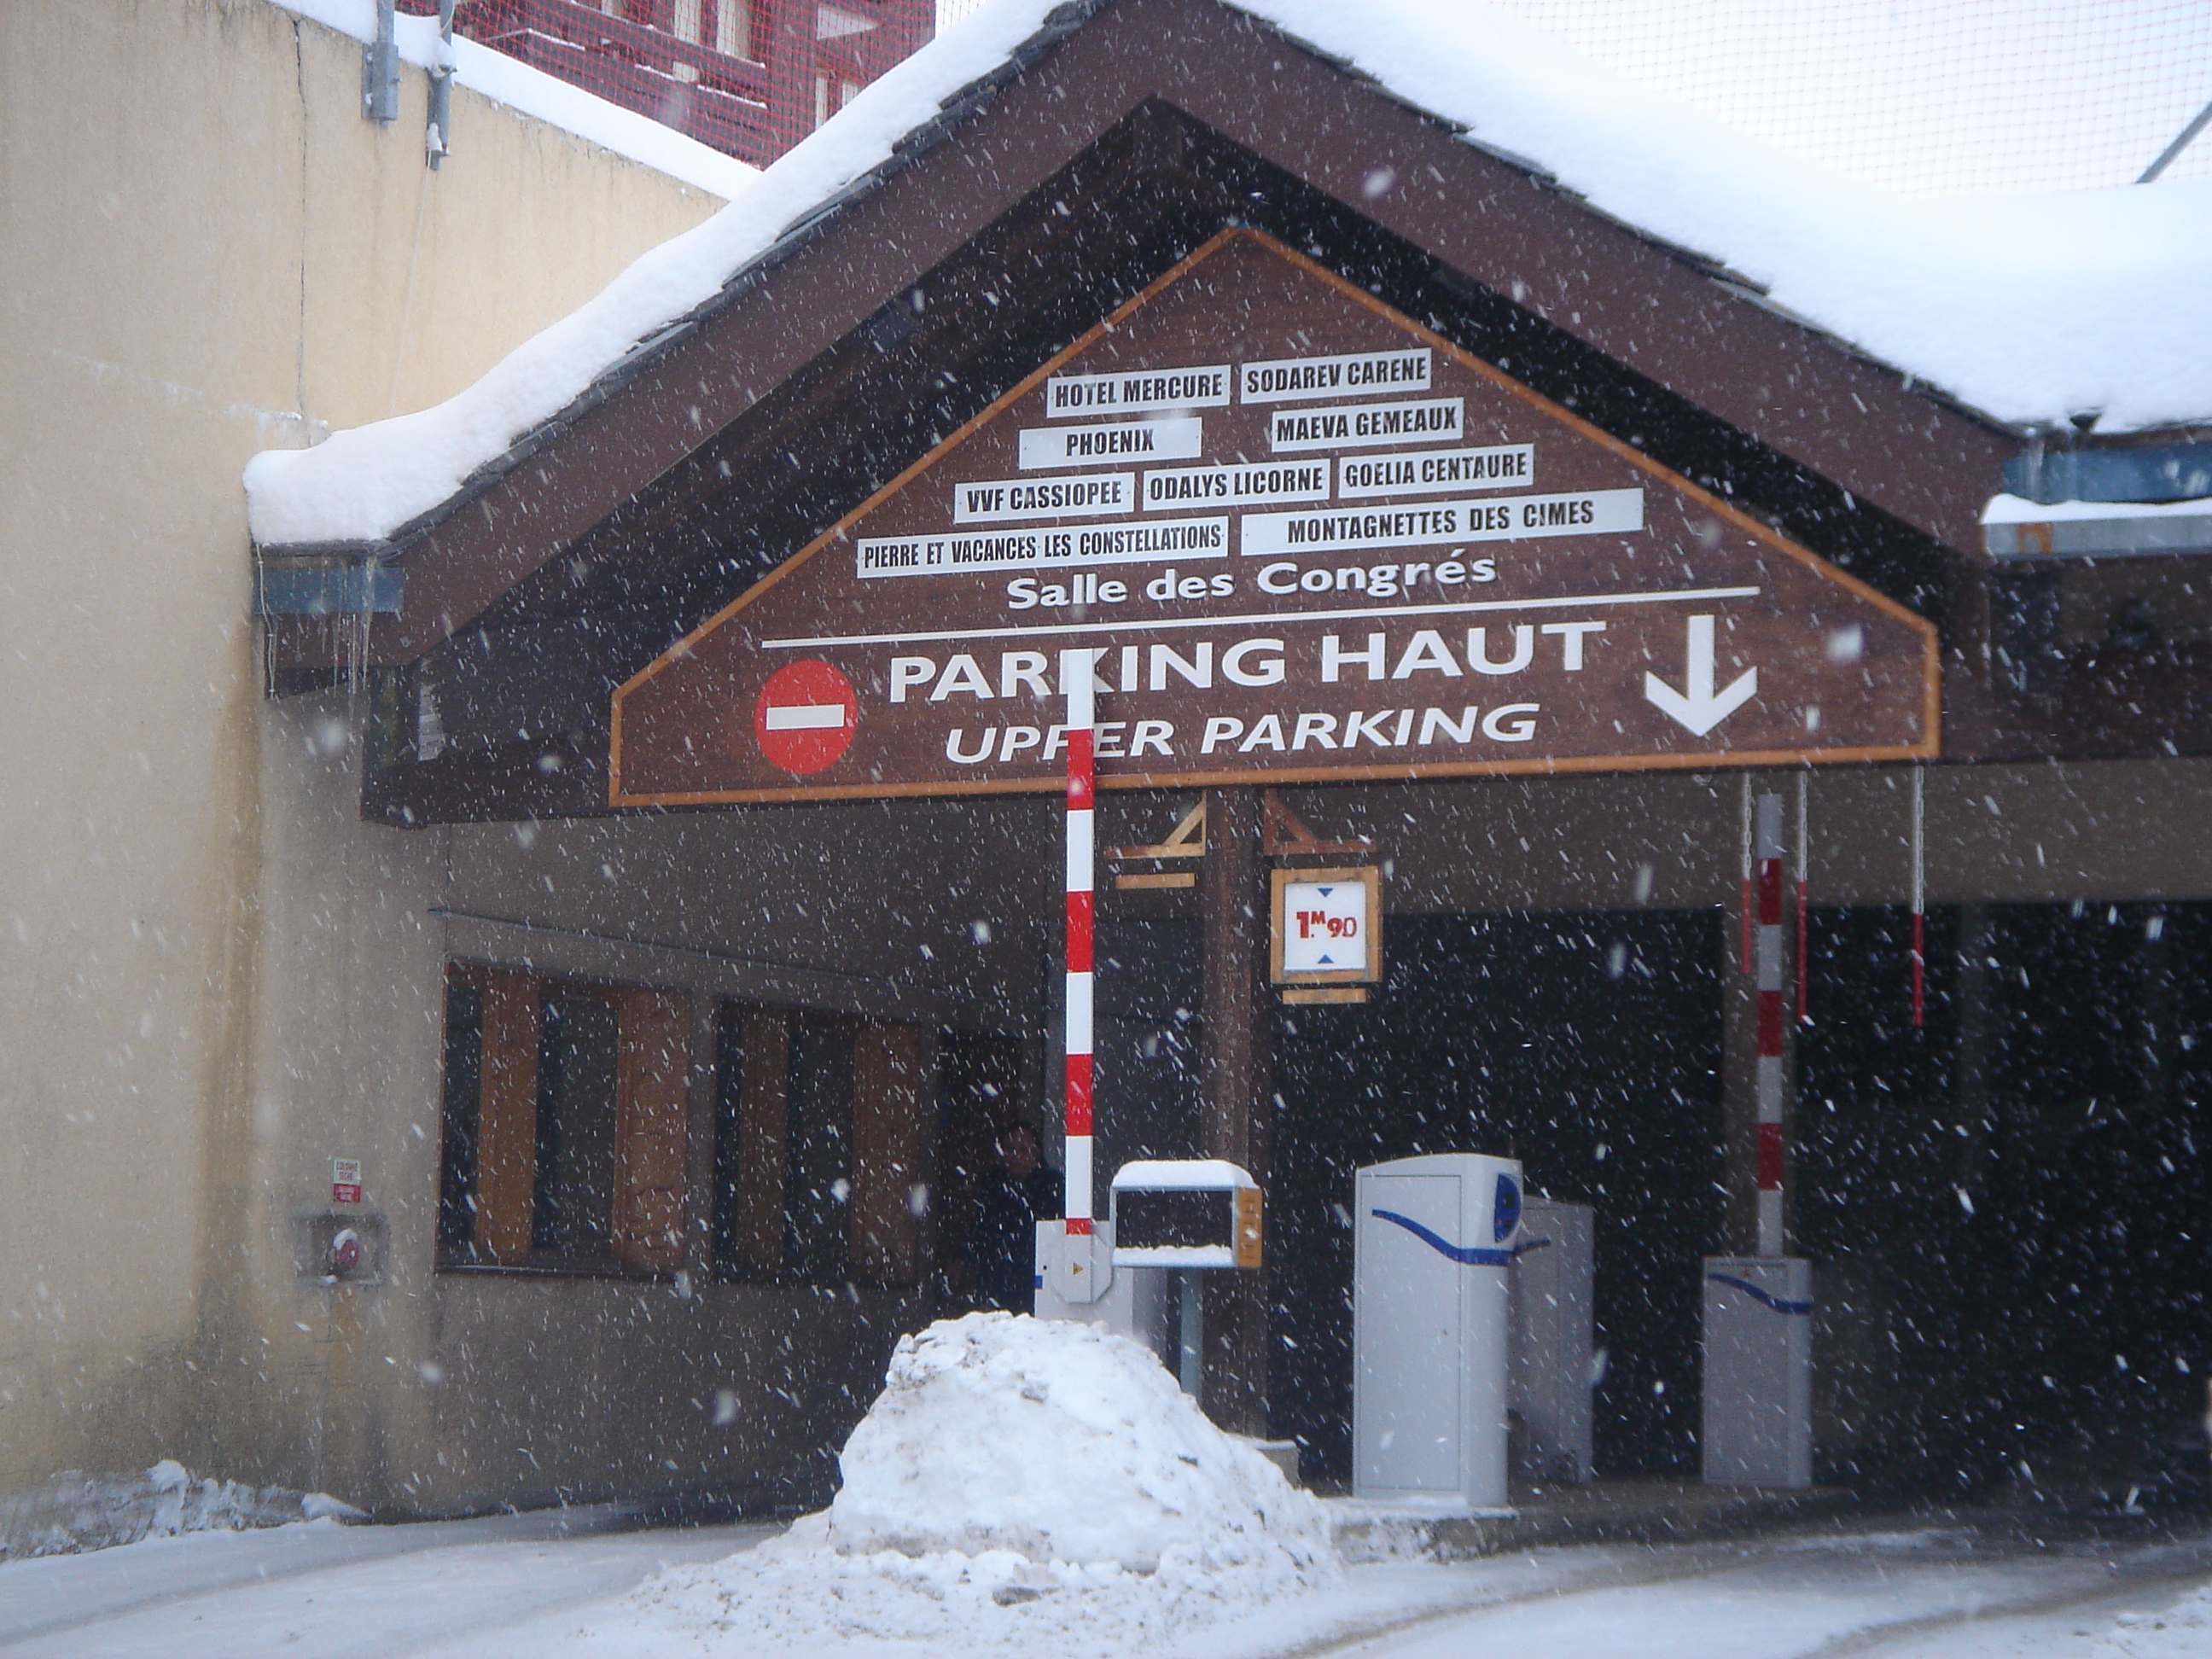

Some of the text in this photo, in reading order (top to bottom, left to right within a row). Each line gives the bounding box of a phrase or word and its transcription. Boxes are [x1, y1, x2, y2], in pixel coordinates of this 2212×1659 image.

[1055, 373, 1223, 408] HOTEL MERCURE
[1247, 356, 1427, 393] SODAREV CARENE
[1277, 406, 1457, 442] MAEVA GEMEAUX
[1066, 428, 1155, 457] PHOENIX
[1150, 467, 1323, 501] ODALYS LICORNE
[1345, 452, 1527, 487] GOELIA CENTAURE
[966, 482, 1121, 513] VVF CASSIOPEE
[1288, 499, 1594, 544] MONTAGNETTES DES CIMES
[864, 524, 1222, 568] PIERRE ET VACANCES LES CONSTELLATIONS
[1007, 548, 1497, 609] Salle des Congrés
[890, 620, 1606, 703] PARKING HAUT
[1200, 703, 1540, 754] PARKING
